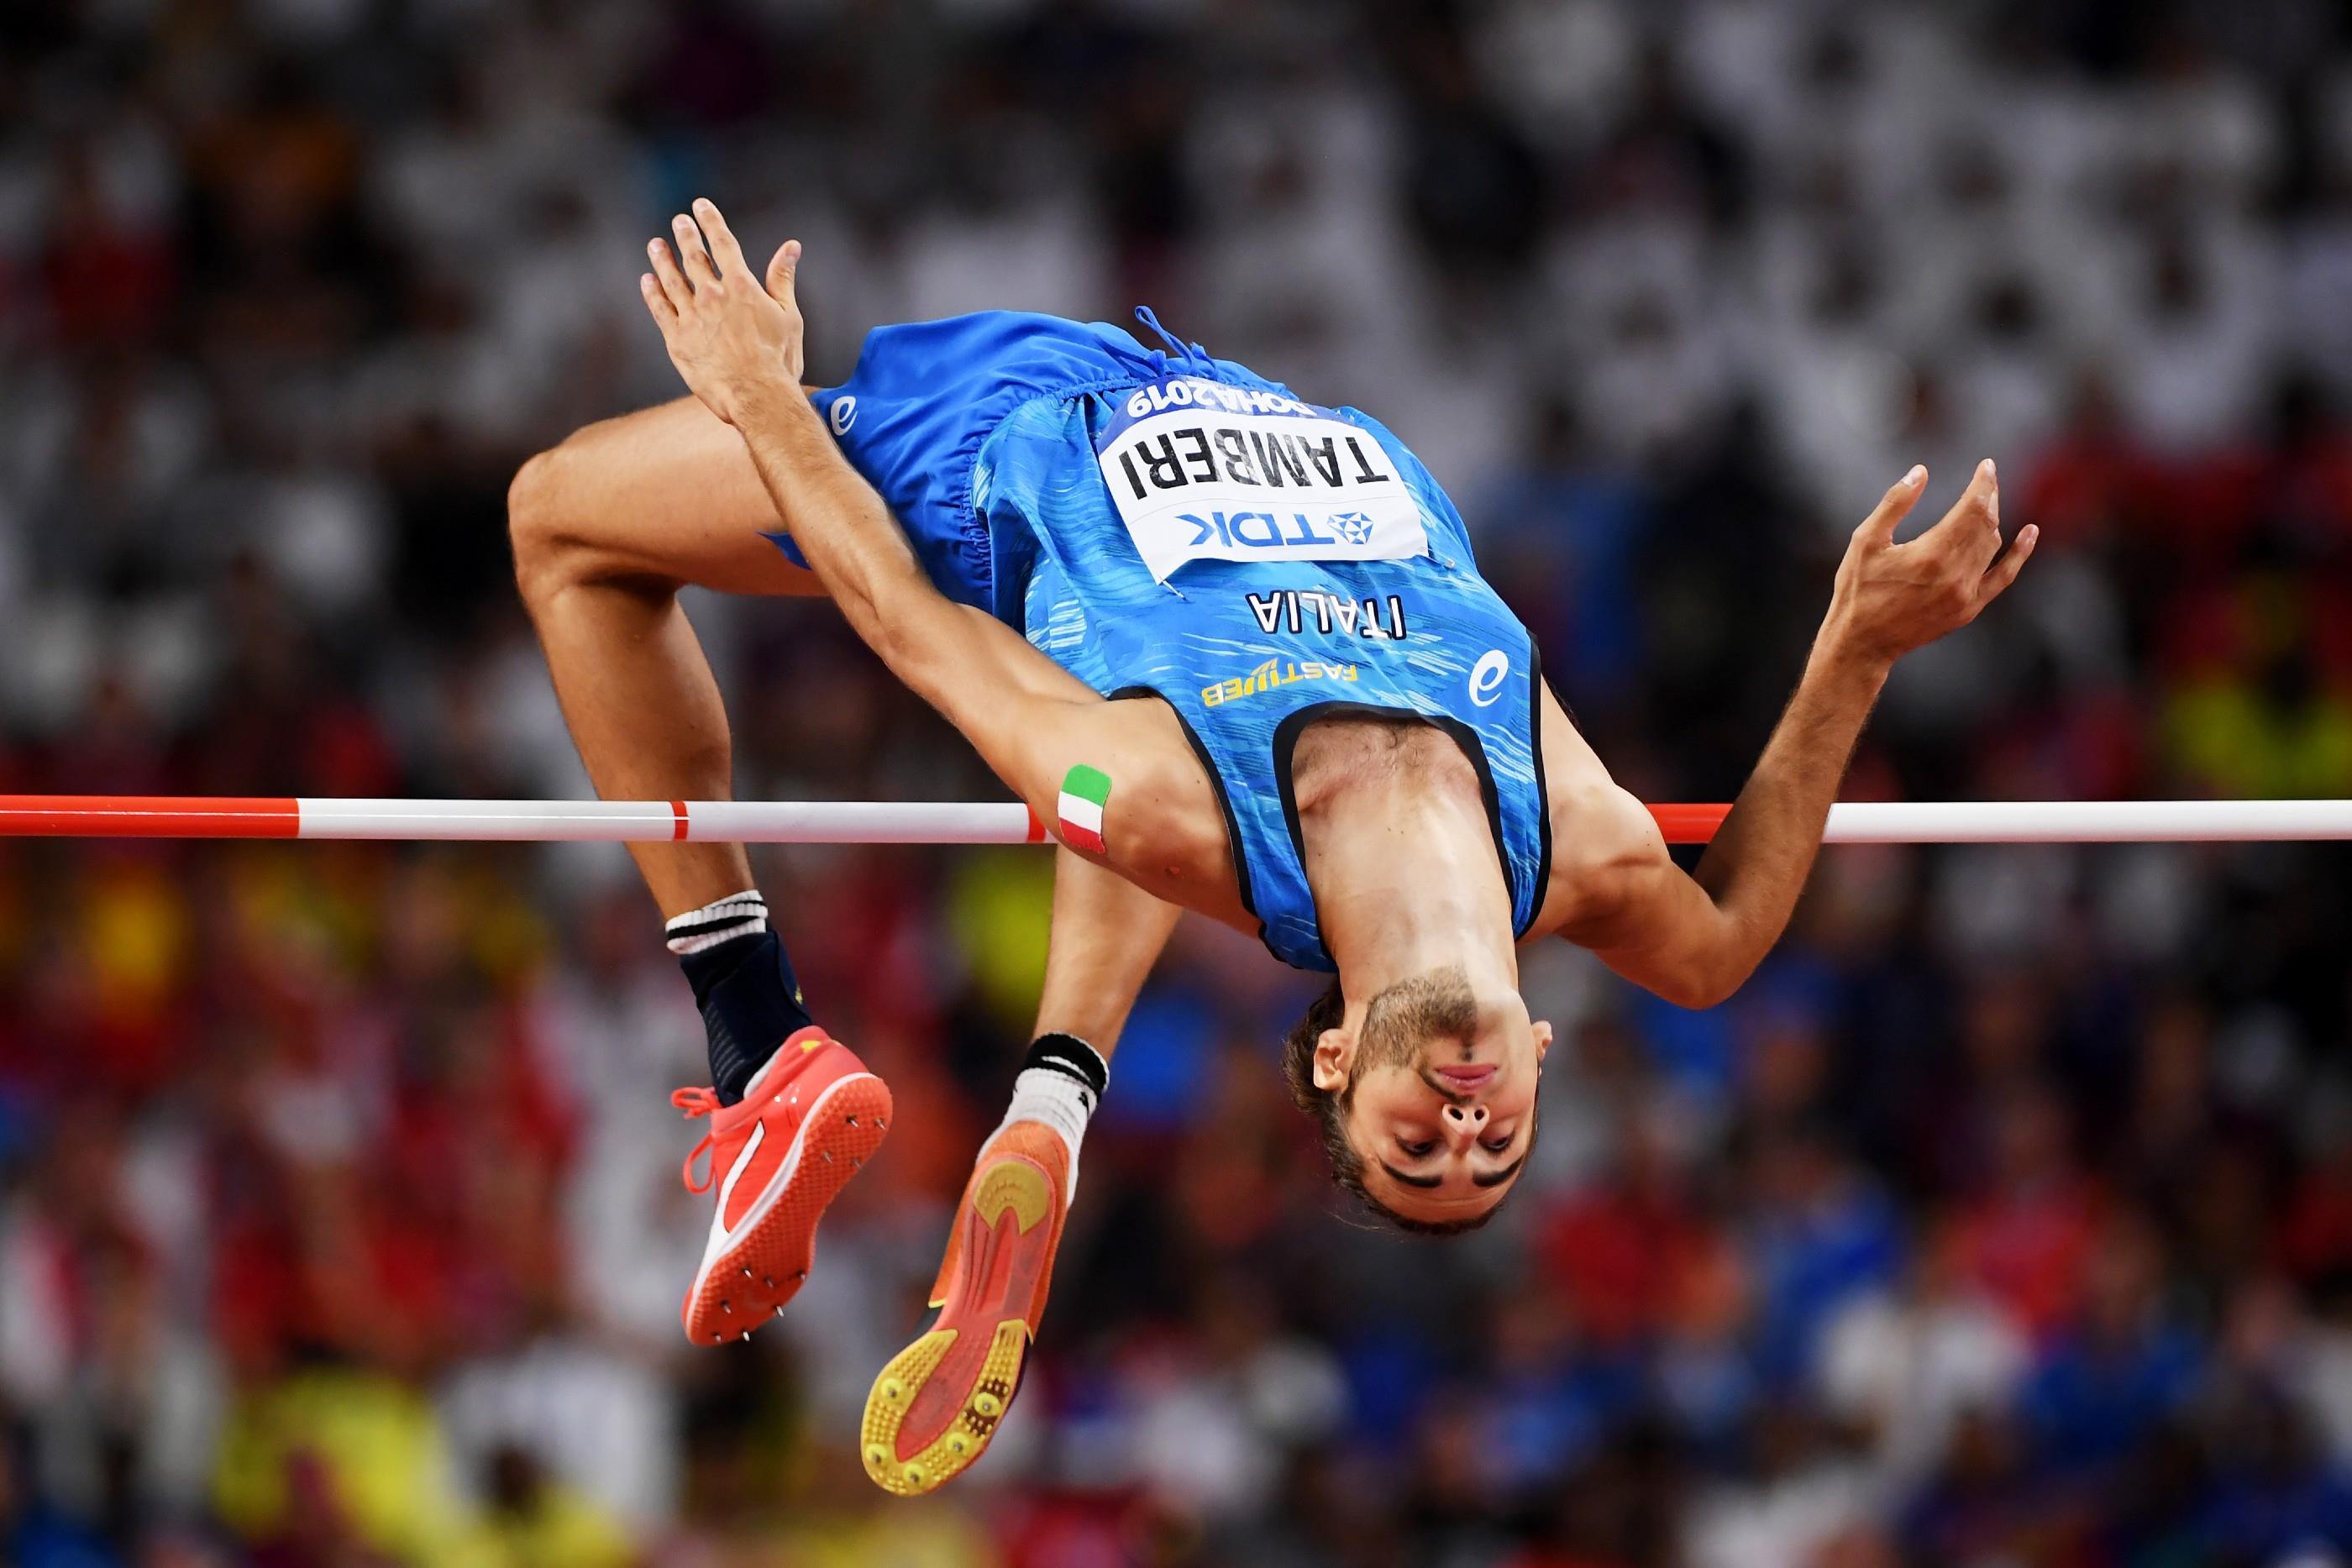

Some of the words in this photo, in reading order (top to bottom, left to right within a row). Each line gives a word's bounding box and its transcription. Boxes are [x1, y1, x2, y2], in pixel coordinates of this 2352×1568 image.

[1119, 428, 1389, 500] TAMBERI
[1173, 511, 1336, 547] TDK
[1246, 590, 1406, 640] ITALIA
[1201, 658, 1357, 707] FASTWEB
